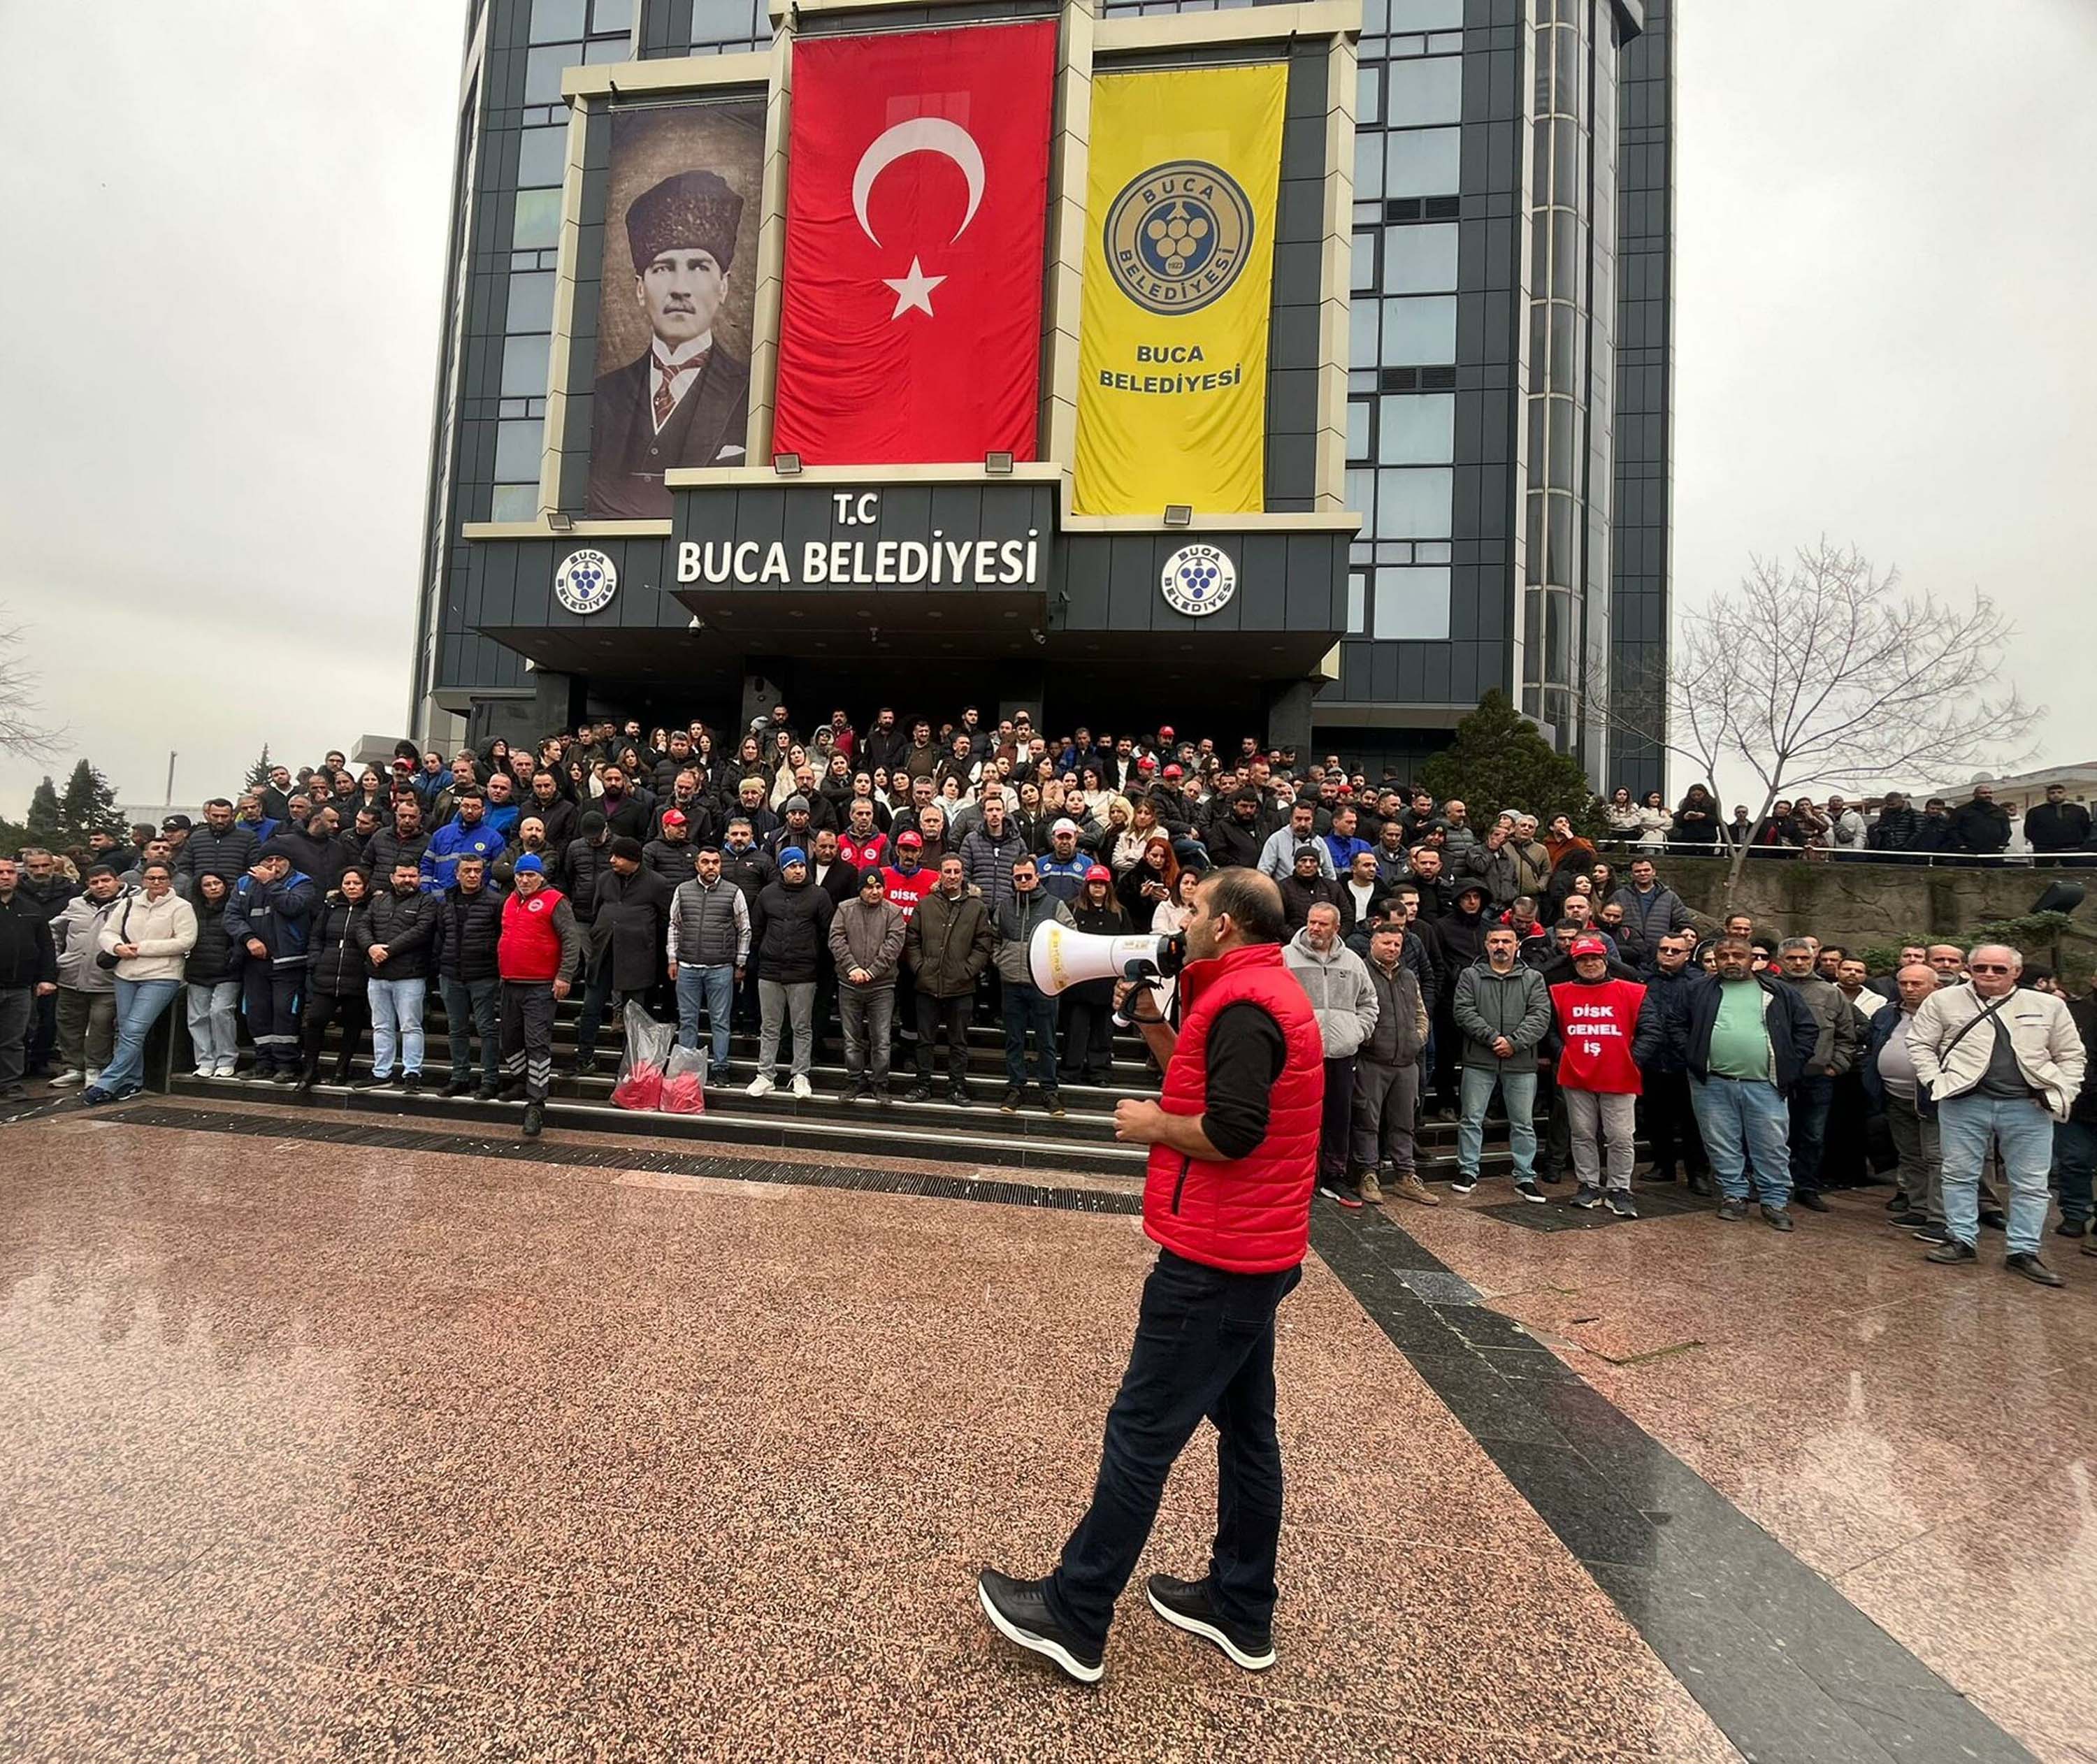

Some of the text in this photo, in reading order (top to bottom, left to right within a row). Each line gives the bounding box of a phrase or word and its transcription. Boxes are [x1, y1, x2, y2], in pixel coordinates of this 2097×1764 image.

[1142, 178, 1214, 203] BUCA
[1119, 247, 1235, 301] BELEDİYESİ
[1137, 345, 1204, 363] BUCA
[1100, 363, 1241, 393] BELEDİYESİ
[833, 493, 878, 526] T.C
[569, 551, 605, 565] BUCA
[677, 529, 1038, 584] BUCA BELEDİYESİ
[1178, 547, 1220, 561] BUCA
[890, 888, 918, 902] DİSK
[1573, 1004, 1613, 1018] DİSK
[1567, 1024, 1622, 1036] GENEL
[1583, 1040, 1601, 1057] İŞ
